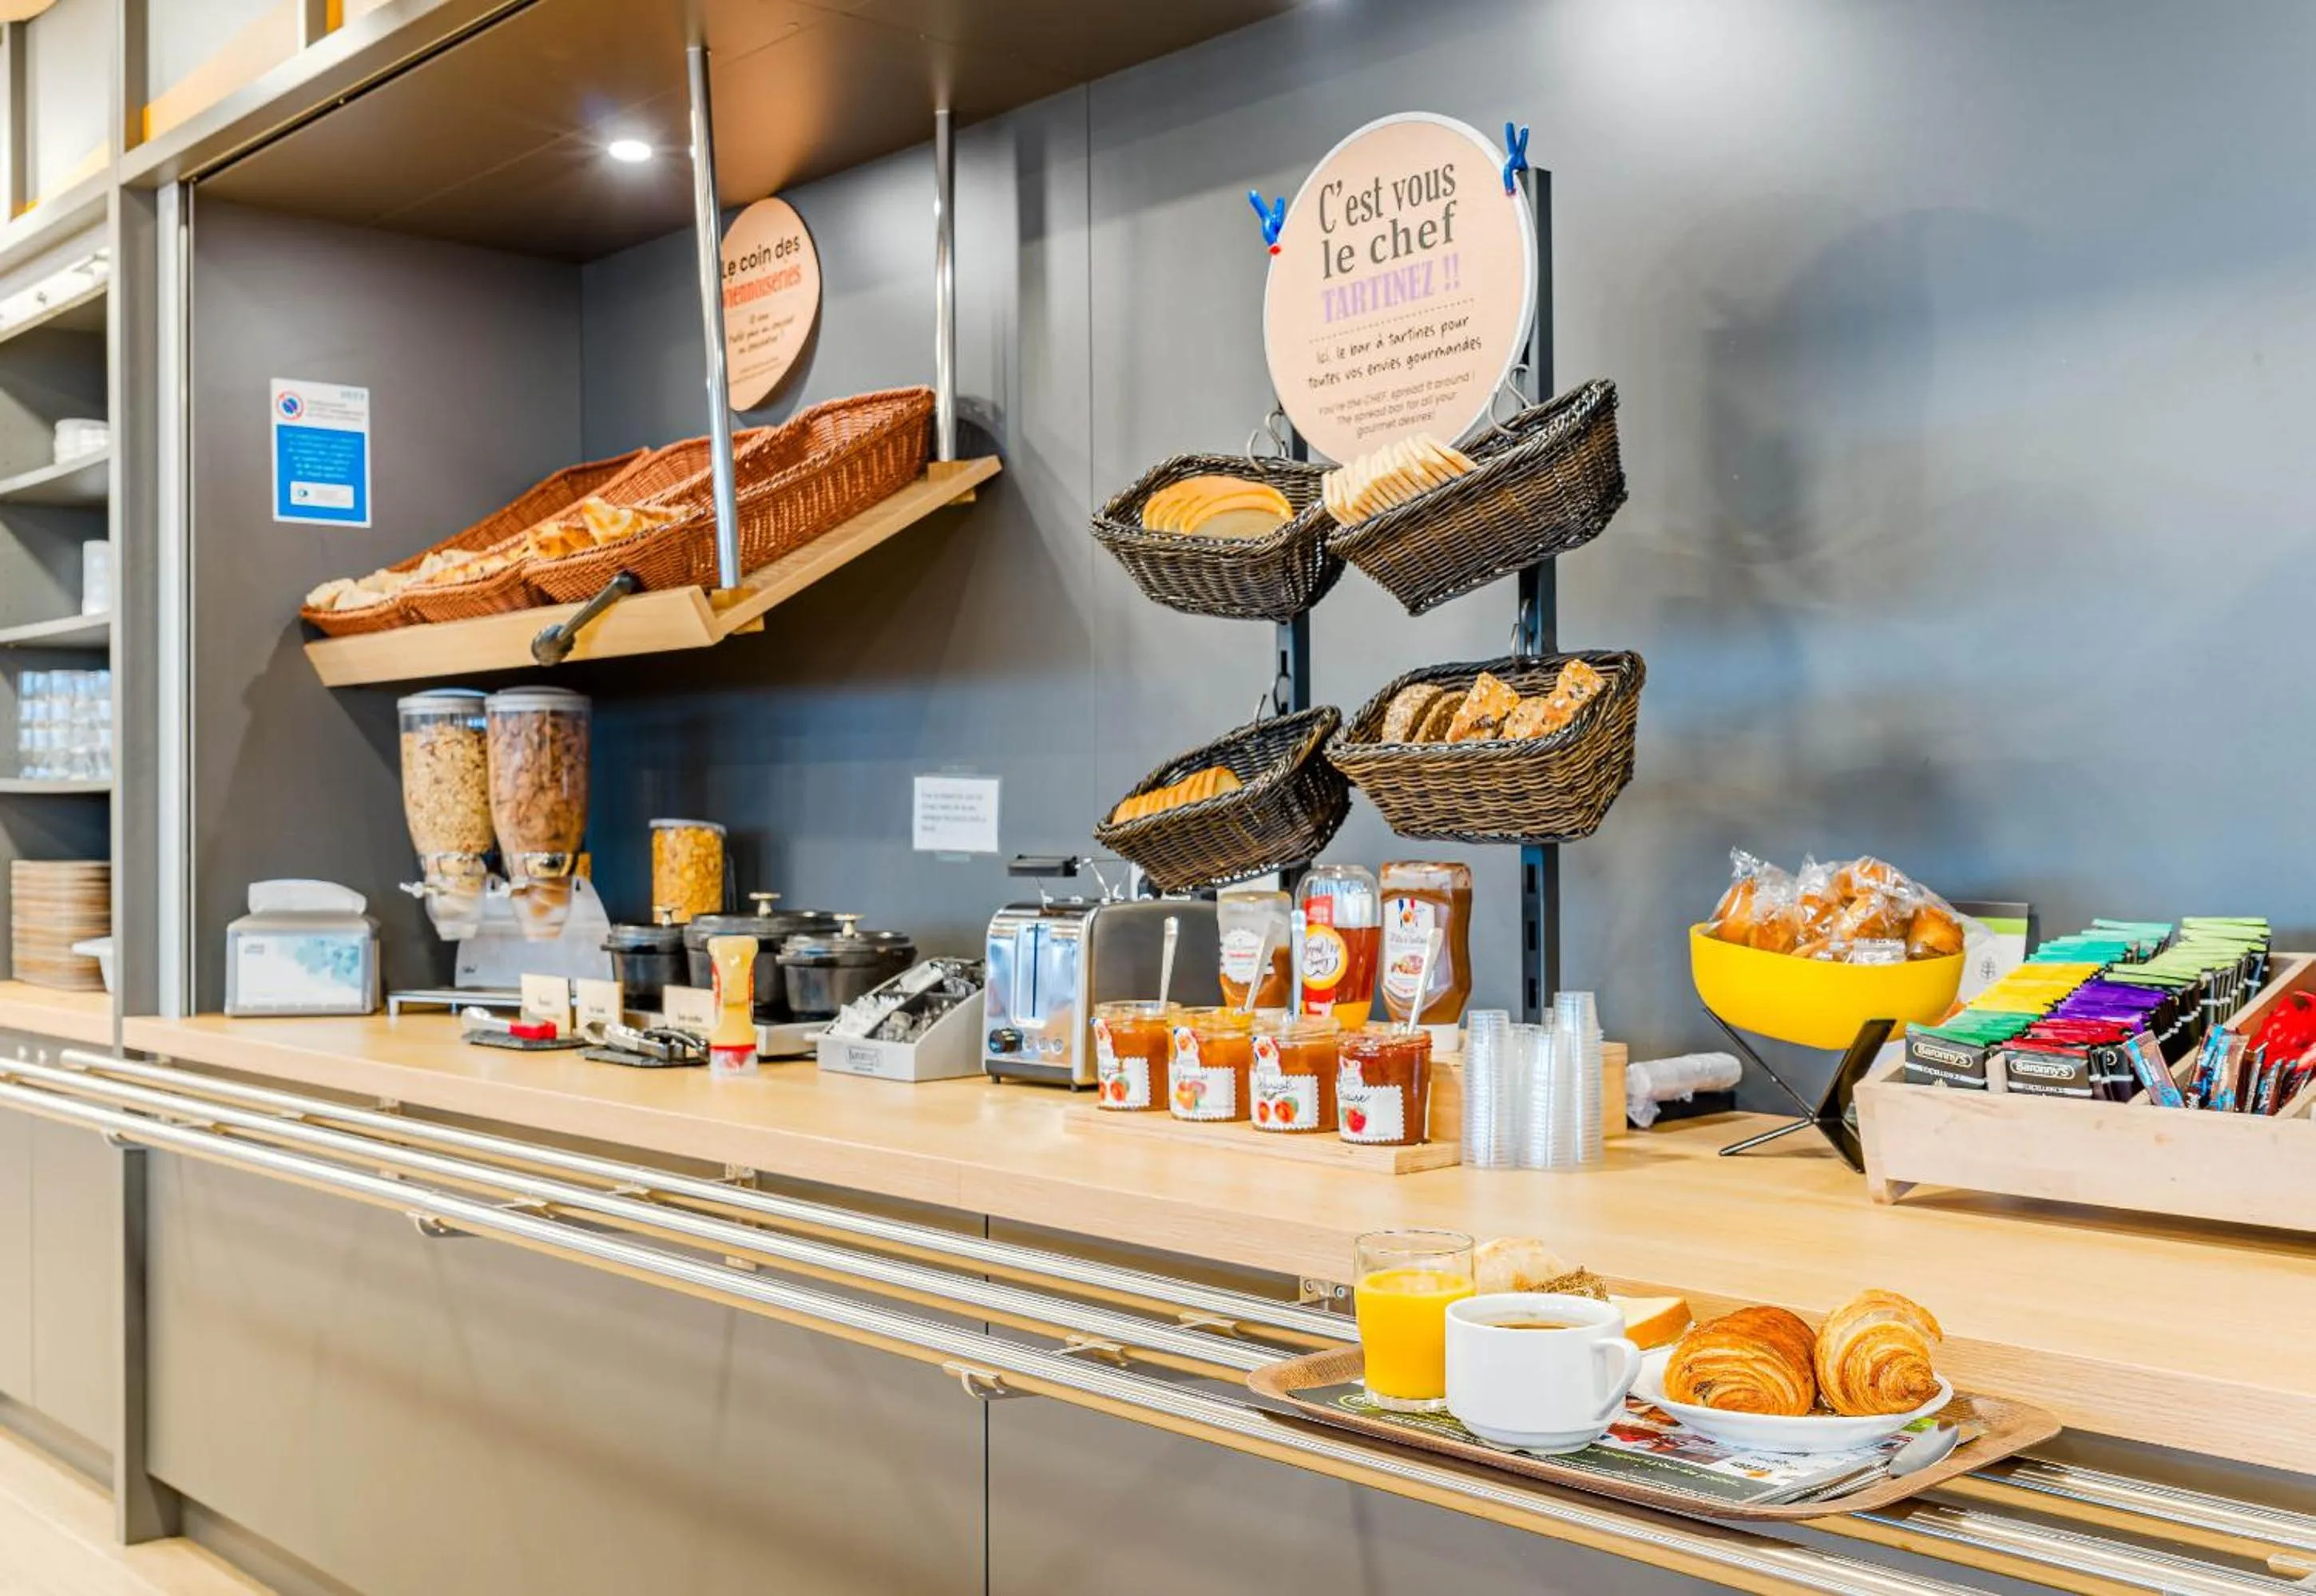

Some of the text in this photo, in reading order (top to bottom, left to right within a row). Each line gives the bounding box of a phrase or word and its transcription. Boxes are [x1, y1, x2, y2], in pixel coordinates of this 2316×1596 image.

[1319, 163, 1457, 234] C'est vous
[740, 244, 771, 272] coin
[775, 236, 800, 259] des
[1322, 200, 1457, 280] le chef
[1322, 260, 1434, 323] TARTINEZ
[1308, 335, 1482, 390] toutes vos envies gourmandes
[1350, 341, 1372, 357] bar
[1388, 324, 1436, 345] tartines
[1440, 316, 1469, 338] pour
